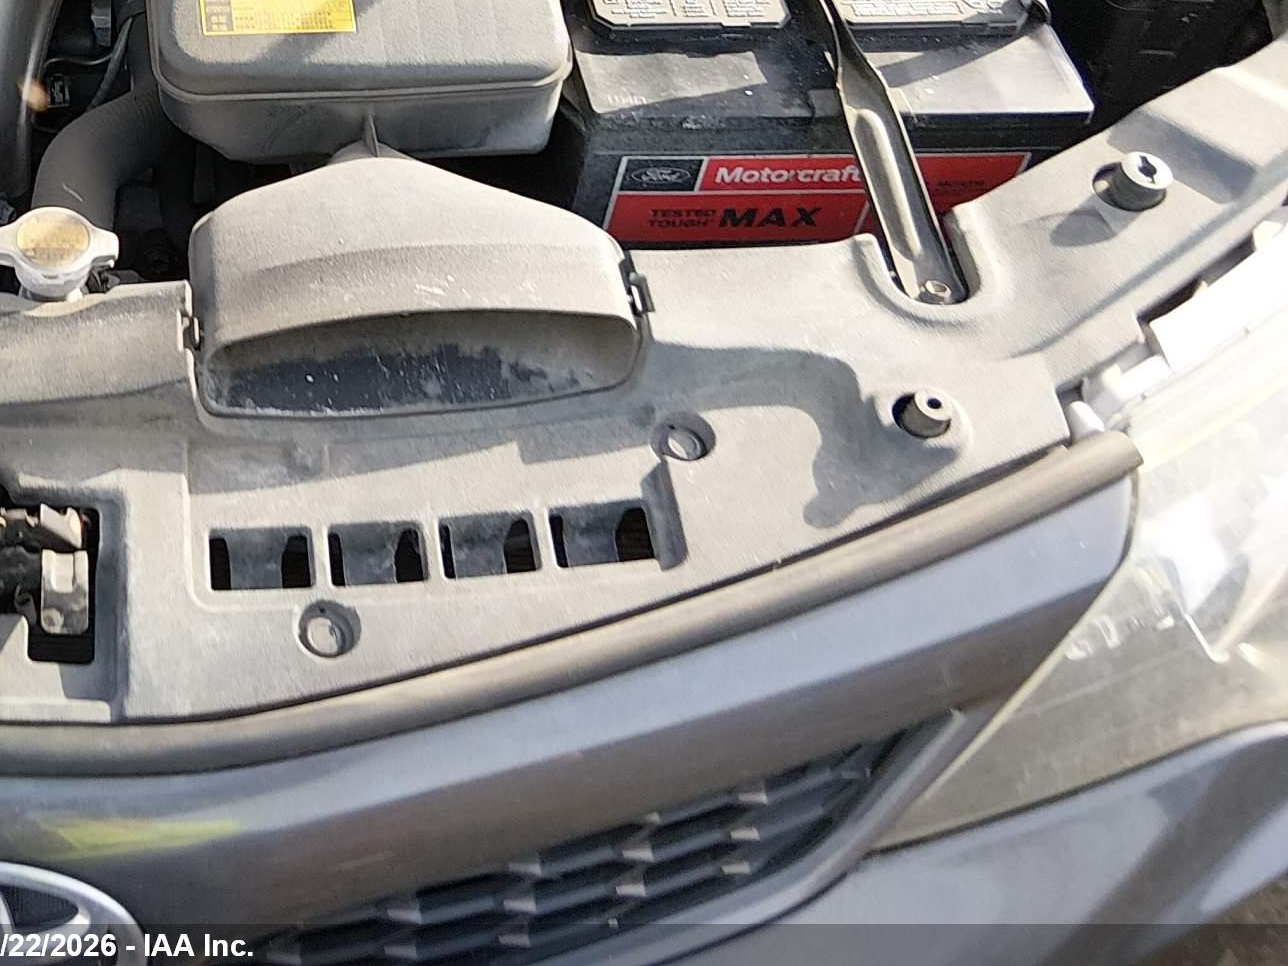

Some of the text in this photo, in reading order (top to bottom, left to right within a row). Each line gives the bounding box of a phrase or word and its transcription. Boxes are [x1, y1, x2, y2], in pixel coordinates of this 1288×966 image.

[714, 166, 862, 185] Motorcraft
[648, 208, 716, 218] TESTED
[719, 206, 822, 228] MAX
